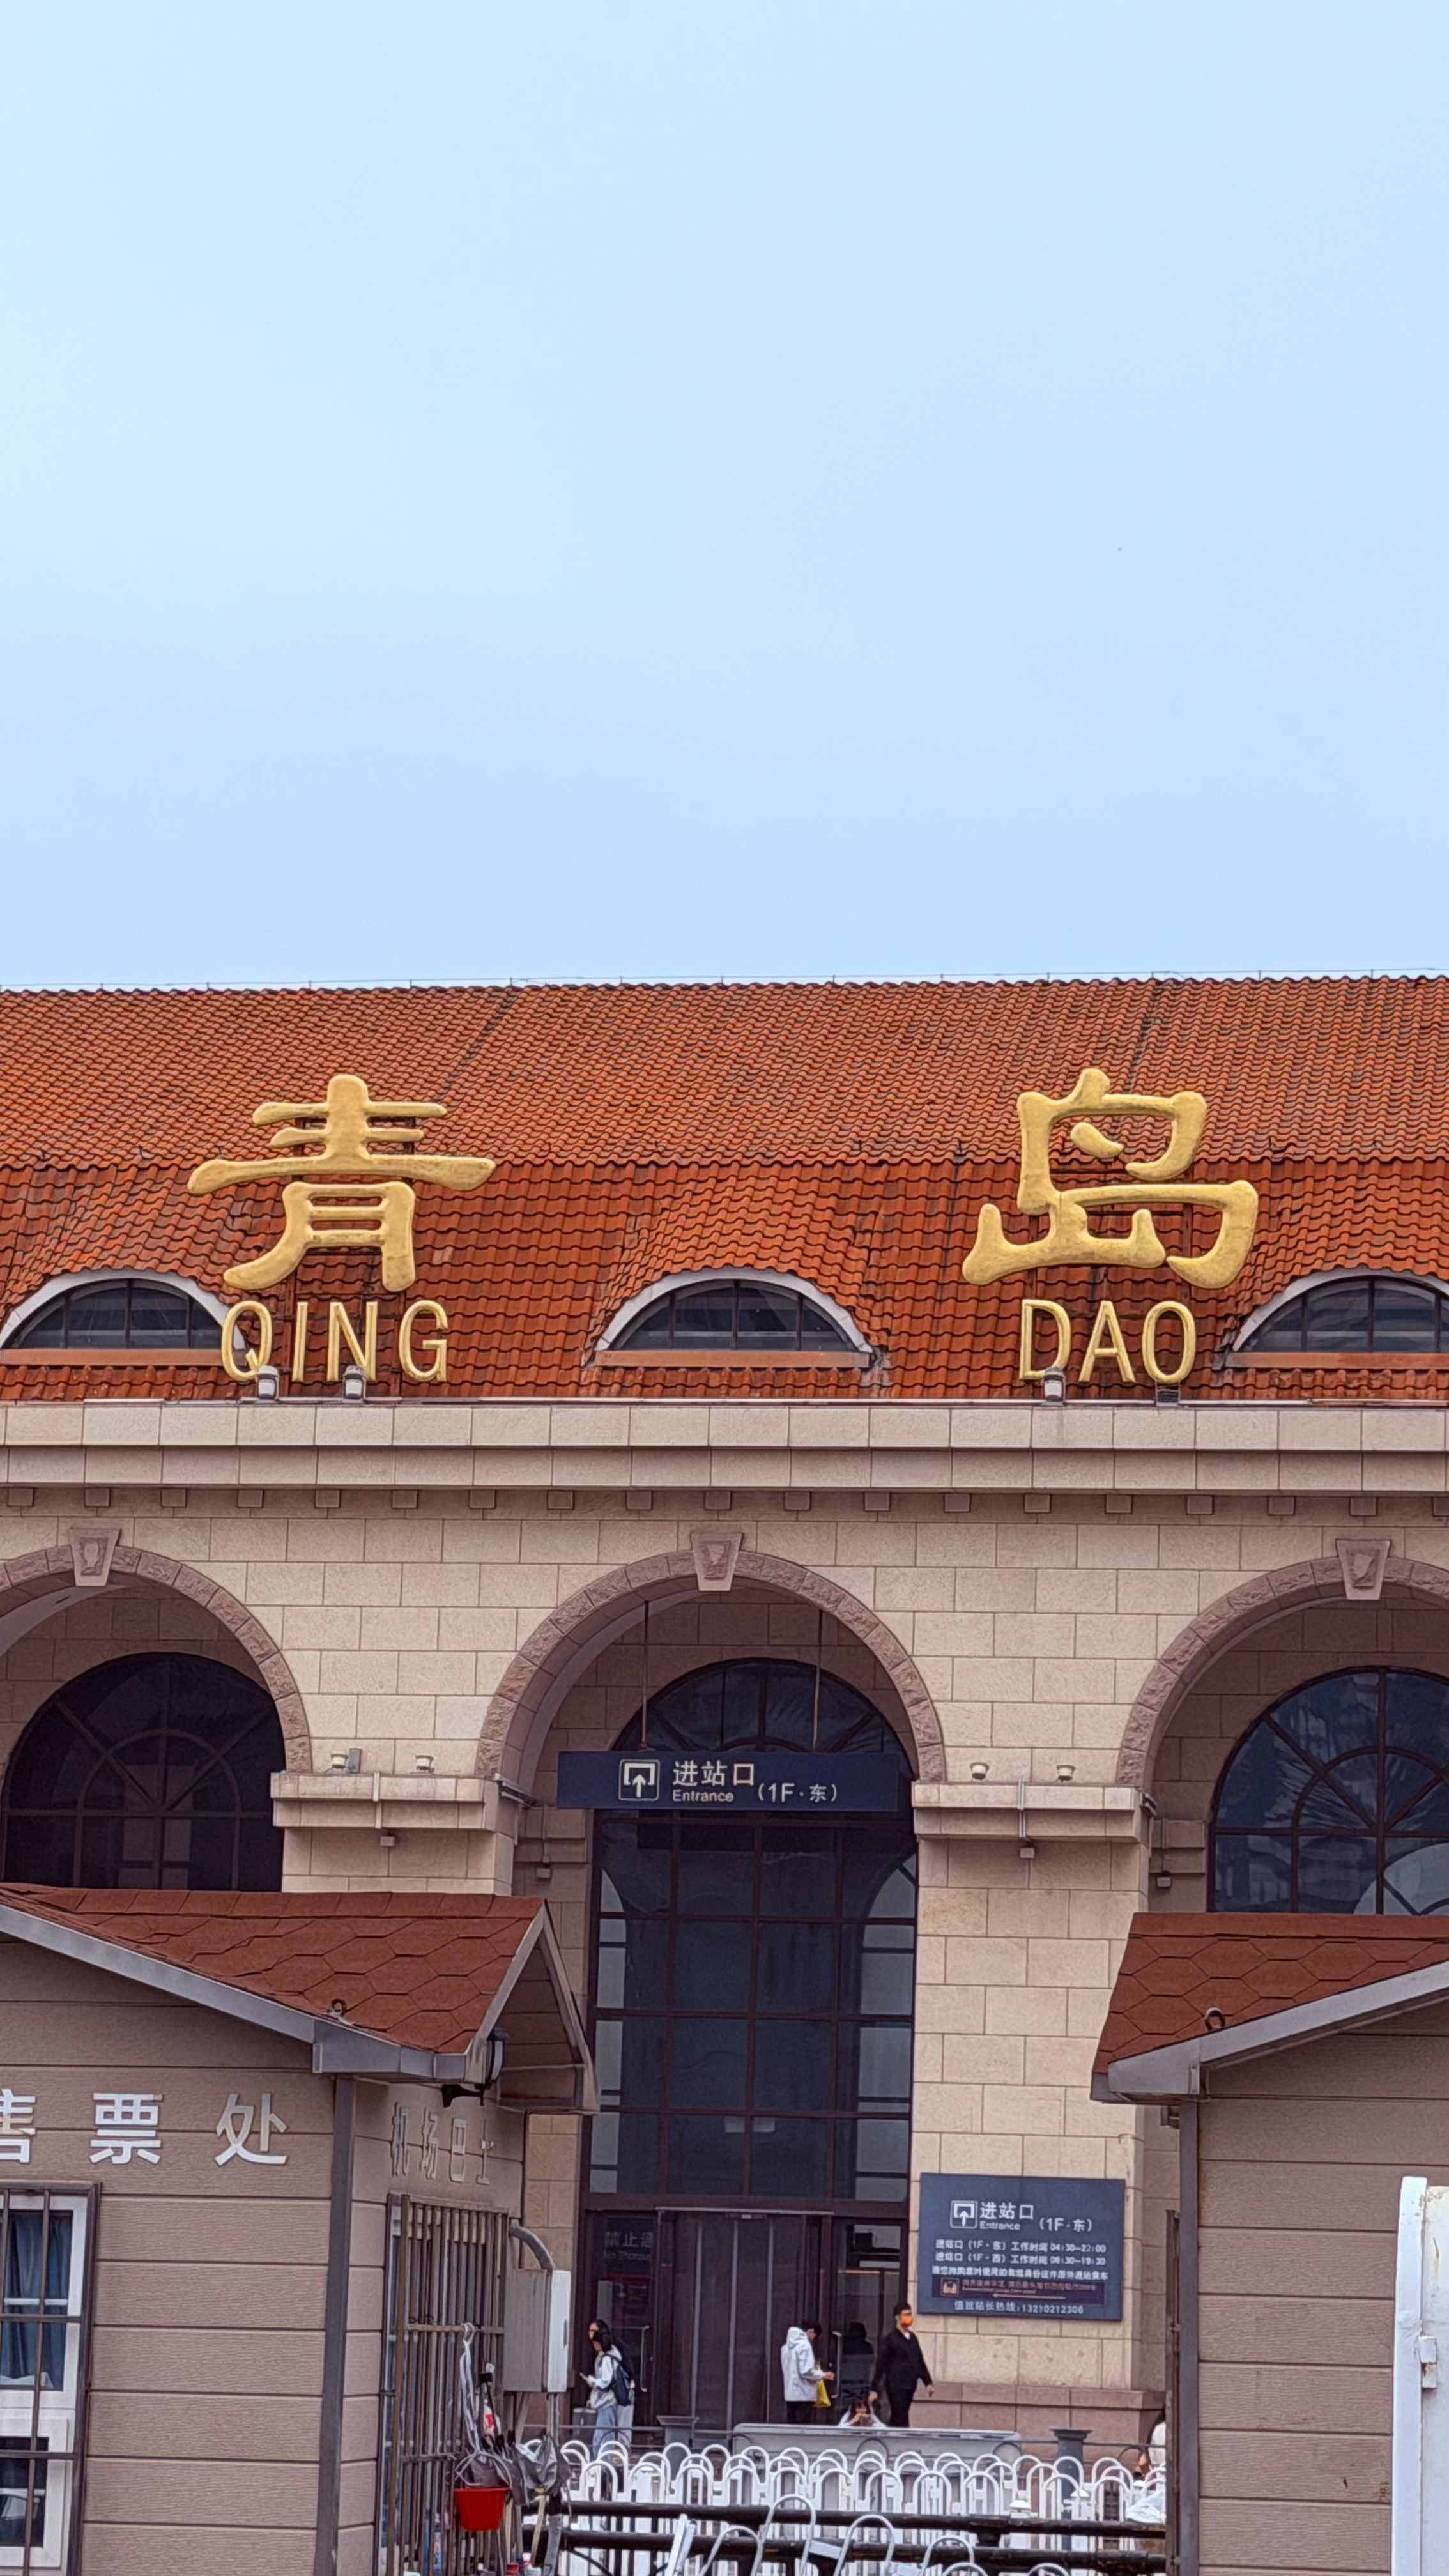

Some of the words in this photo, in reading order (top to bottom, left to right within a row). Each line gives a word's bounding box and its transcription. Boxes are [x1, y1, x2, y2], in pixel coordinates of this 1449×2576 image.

[187, 1073, 497, 1292] 青
[962, 1068, 1259, 1289] 岛
[220, 1300, 448, 1383] QING
[1018, 1298, 1197, 1385] DAO
[672, 1759, 755, 1787] 进站口
[673, 1789, 735, 1802] Entrance
[979, 2201, 1034, 2221] 进站口
[979, 2220, 1021, 2231] Entrance
